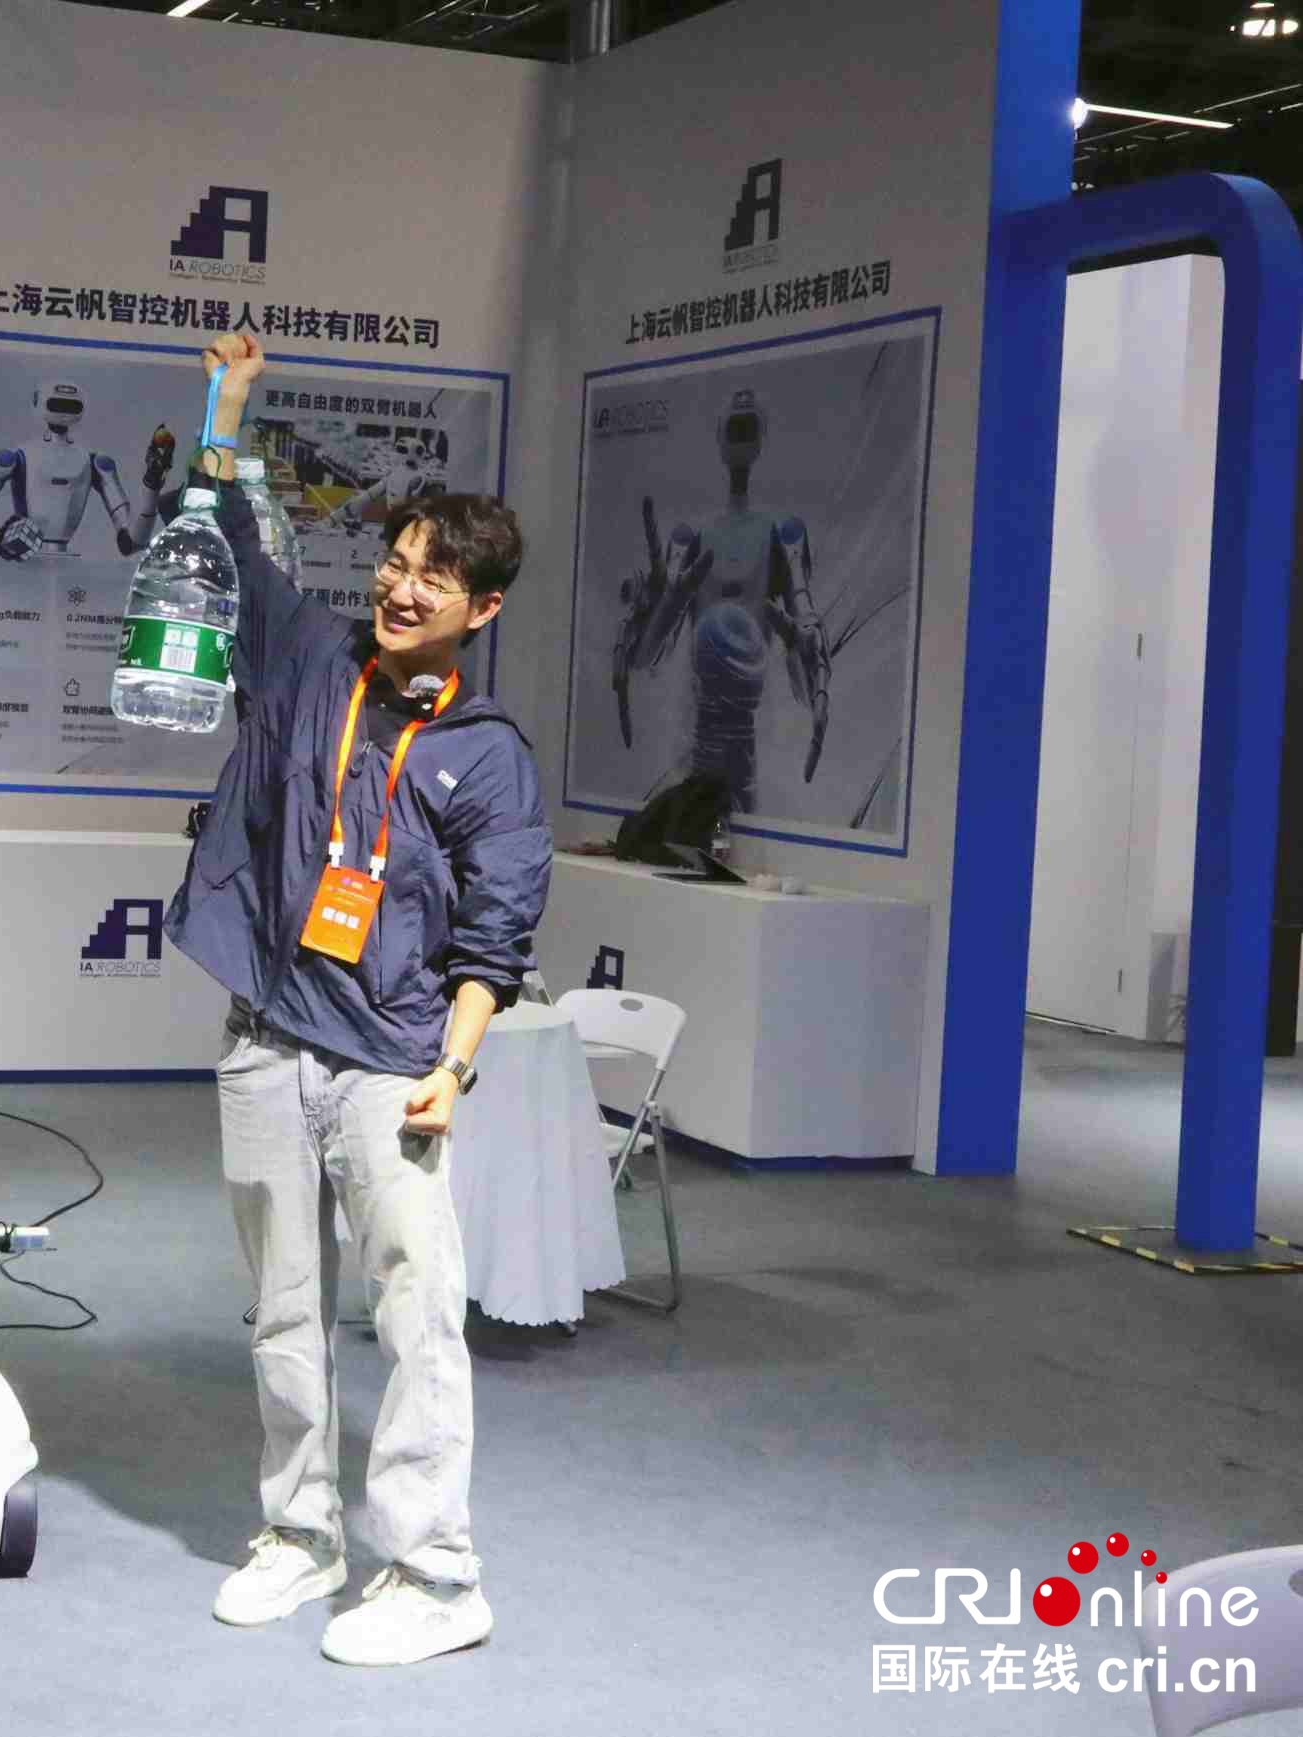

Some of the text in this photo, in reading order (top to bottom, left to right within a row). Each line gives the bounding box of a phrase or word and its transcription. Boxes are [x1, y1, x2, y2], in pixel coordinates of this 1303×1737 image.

[626, 260, 891, 344] 上海云帆智控机器人科技有限公司
